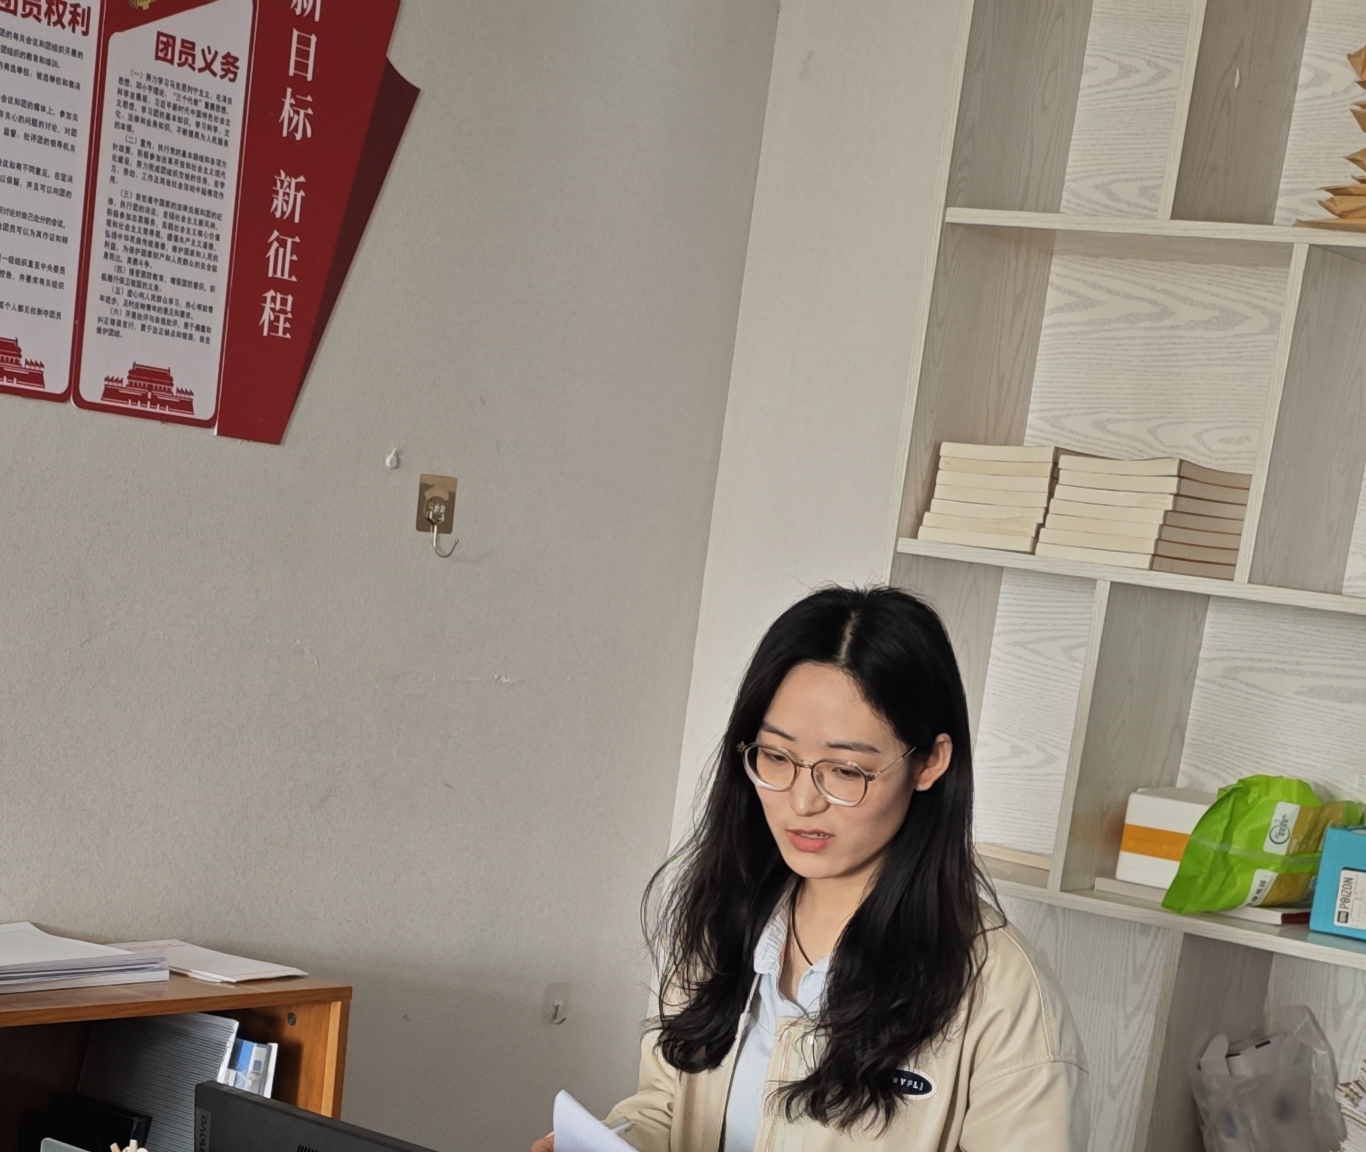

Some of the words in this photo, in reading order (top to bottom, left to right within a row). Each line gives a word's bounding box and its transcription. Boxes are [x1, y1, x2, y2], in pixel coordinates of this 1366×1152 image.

[154, 30, 240, 83] 团员义务
[258, 168, 307, 340] 新征程
[1339, 876, 1355, 910] POIZON
